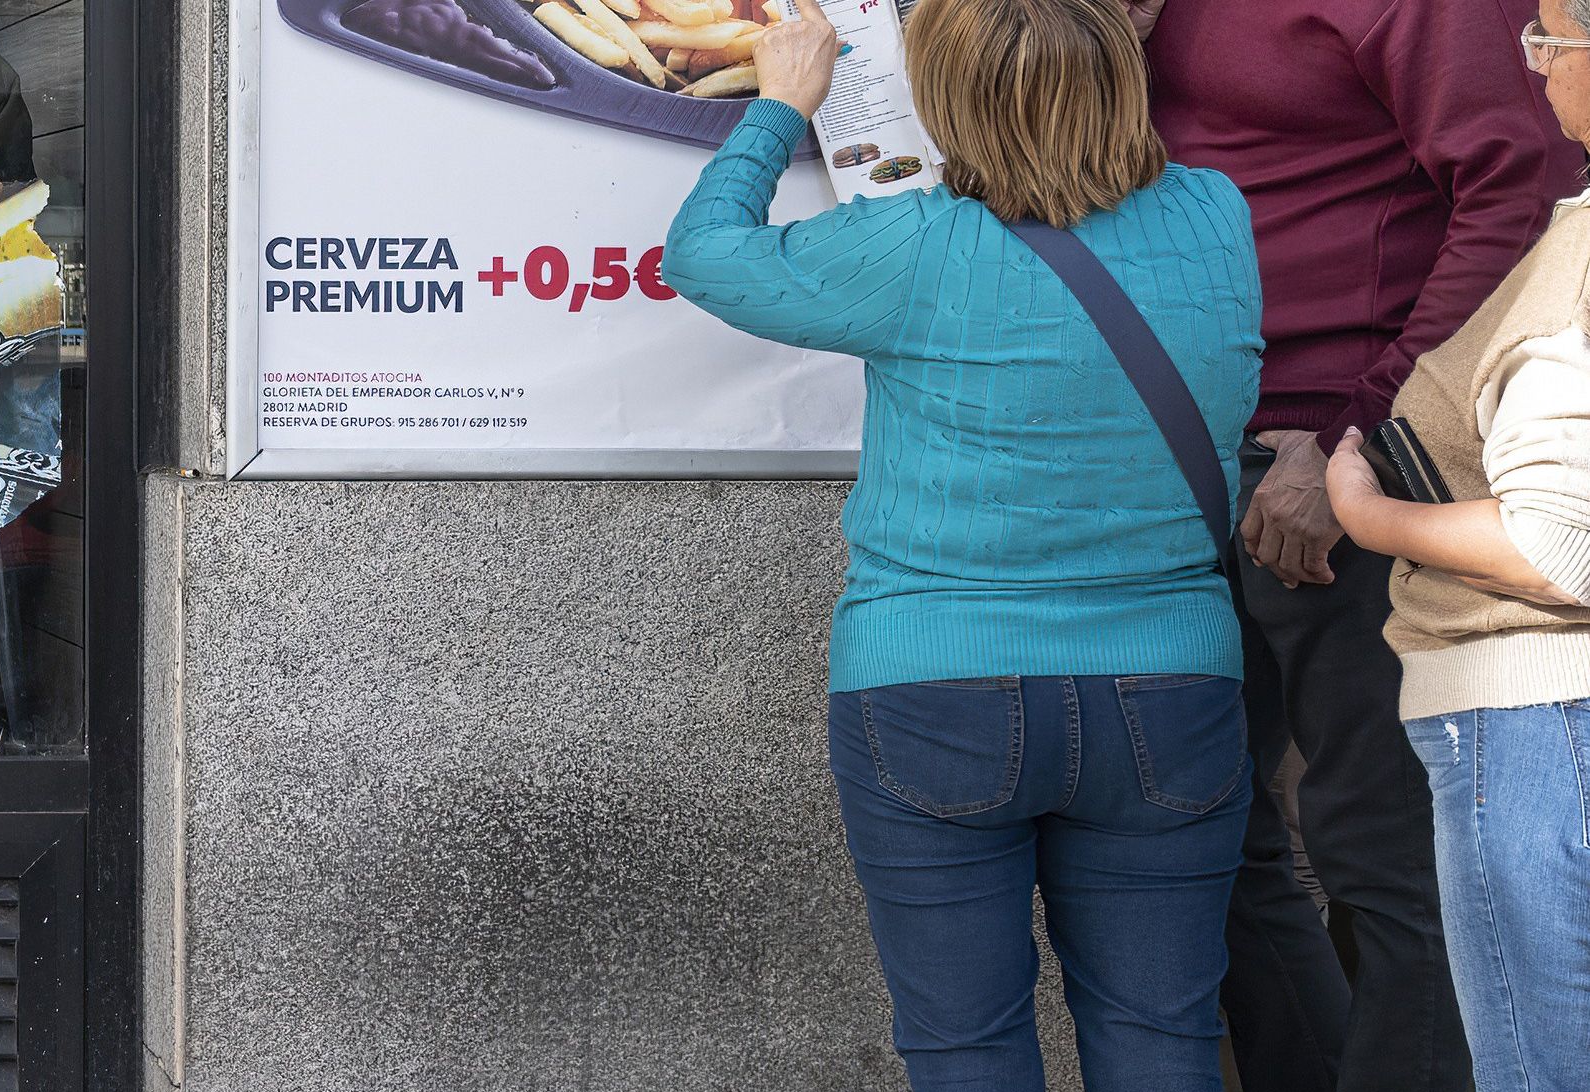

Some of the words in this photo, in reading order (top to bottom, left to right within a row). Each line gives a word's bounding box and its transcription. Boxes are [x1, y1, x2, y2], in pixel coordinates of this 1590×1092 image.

[264, 236, 459, 271] CERVEZA
[265, 280, 464, 313] PREMIUM
[263, 372, 283, 383] 100
[286, 372, 368, 383] MONTADITOS
[370, 372, 423, 383] ATOCHA
[263, 387, 323, 398] GLORIETA
[326, 387, 349, 398] DEL
[352, 387, 431, 398] EMPERADOR
[434, 387, 484, 398] CARLOS
[486, 387, 498, 399] V,
[517, 388, 525, 398] 9
[263, 402, 295, 412] 28012
[297, 402, 348, 412] MADRID
[263, 417, 318, 427] RESERVA
[321, 417, 338, 427] DE
[340, 417, 395, 427] GRUPOS:
[398, 417, 416, 427] 915
[418, 417, 439, 427] 286
[441, 417, 459, 427] 701
[469, 417, 490, 427] 629
[492, 417, 507, 427] 112
[509, 417, 528, 427] 519
